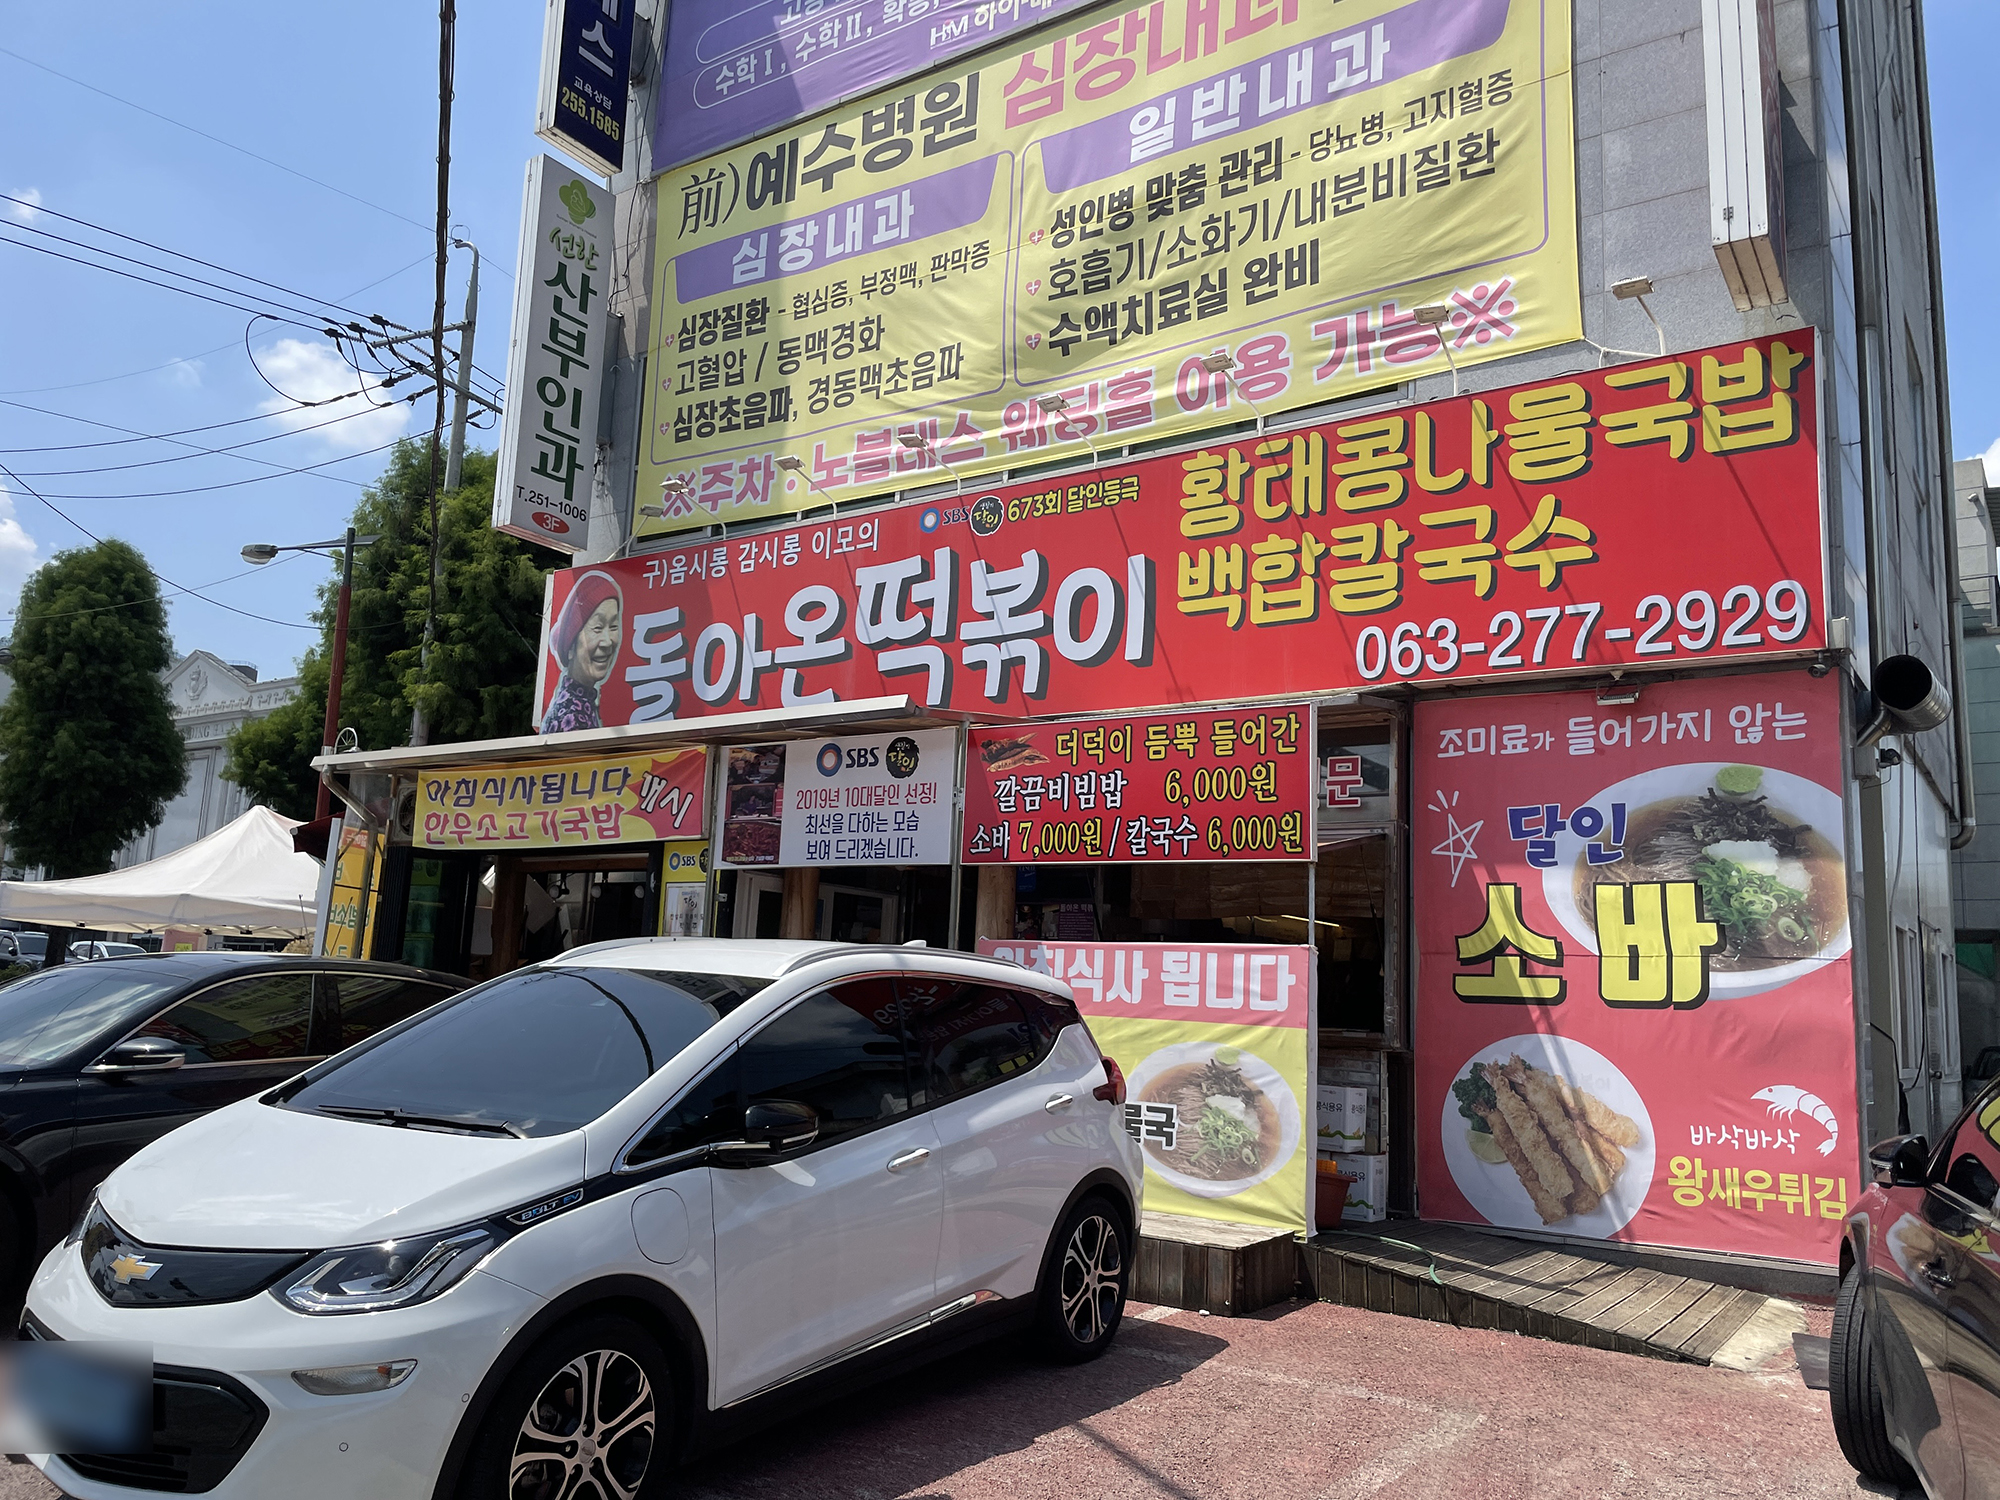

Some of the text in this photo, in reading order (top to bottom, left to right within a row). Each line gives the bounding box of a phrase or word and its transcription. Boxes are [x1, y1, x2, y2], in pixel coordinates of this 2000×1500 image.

[579, 0, 618, 77] 스
[561, 86, 620, 141] 255.1585
[574, 76, 612, 111] 교육상담
[1129, 22, 1391, 164] 일반내과
[1049, 185, 1135, 249] 성인병
[1144, 165, 1208, 223] 맞춤
[1219, 137, 1284, 198] 관리
[1309, 110, 1392, 163] 당뇨병,
[1403, 69, 1514, 131] 고지혈증
[731, 195, 915, 286] 심장내과
[677, 296, 770, 353] 심장질환
[792, 279, 854, 321] 협심증,
[860, 262, 923, 300] 부정맥,
[930, 239, 991, 283] 판막증
[1048, 239, 1321, 357] 수액치료실 완비
[531, 261, 597, 501] 산부인과
[674, 347, 747, 396] 고혈압
[777, 314, 886, 376] 동맥경화
[673, 341, 964, 444] 심장초음파, 경동맥초음파
[811, 411, 985, 490] 노블레스
[1001, 368, 1154, 446] 웨딩홀
[1176, 334, 1290, 412] 이용
[1180, 341, 1807, 540] 황태콩나물국밥
[516, 484, 587, 521] T.251-1006
[543, 514, 560, 531] 3F
[942, 506, 970, 525] SBS
[1007, 476, 1140, 522] 673회 달인등극
[738, 533, 802, 574] 감시롱
[811, 518, 879, 560] 이모의
[1177, 494, 1596, 629] 백합칼국수
[1355, 580, 1808, 680] 063-277-2929
[846, 747, 880, 769] SBS
[1055, 713, 1300, 765] 더덕이 듬뿍 들어간
[1437, 702, 1807, 758] 조미료가 들어가지 않는
[796, 782, 937, 810] 2019년 10대달인 선정!
[994, 761, 1278, 813] 깔끔비빔밥 6,000원
[805, 810, 920, 835] 최선을 다하는 모습
[806, 837, 919, 861] 보여 드리겠습니다.
[970, 821, 1010, 859] 소바
[1019, 818, 1102, 857] 7,000원
[1126, 815, 1199, 858] 칼국수
[1207, 811, 1303, 857] 6,000원
[1507, 802, 1627, 868] 달인
[681, 855, 696, 866] SBS
[1453, 882, 1726, 1009] 소바
[1160, 949, 1297, 1012] 됩니다
[1690, 1124, 1800, 1154] 바삭바삭
[563, 1193, 579, 1204] EV
[1667, 1155, 1847, 1220] 왕새우튀김
